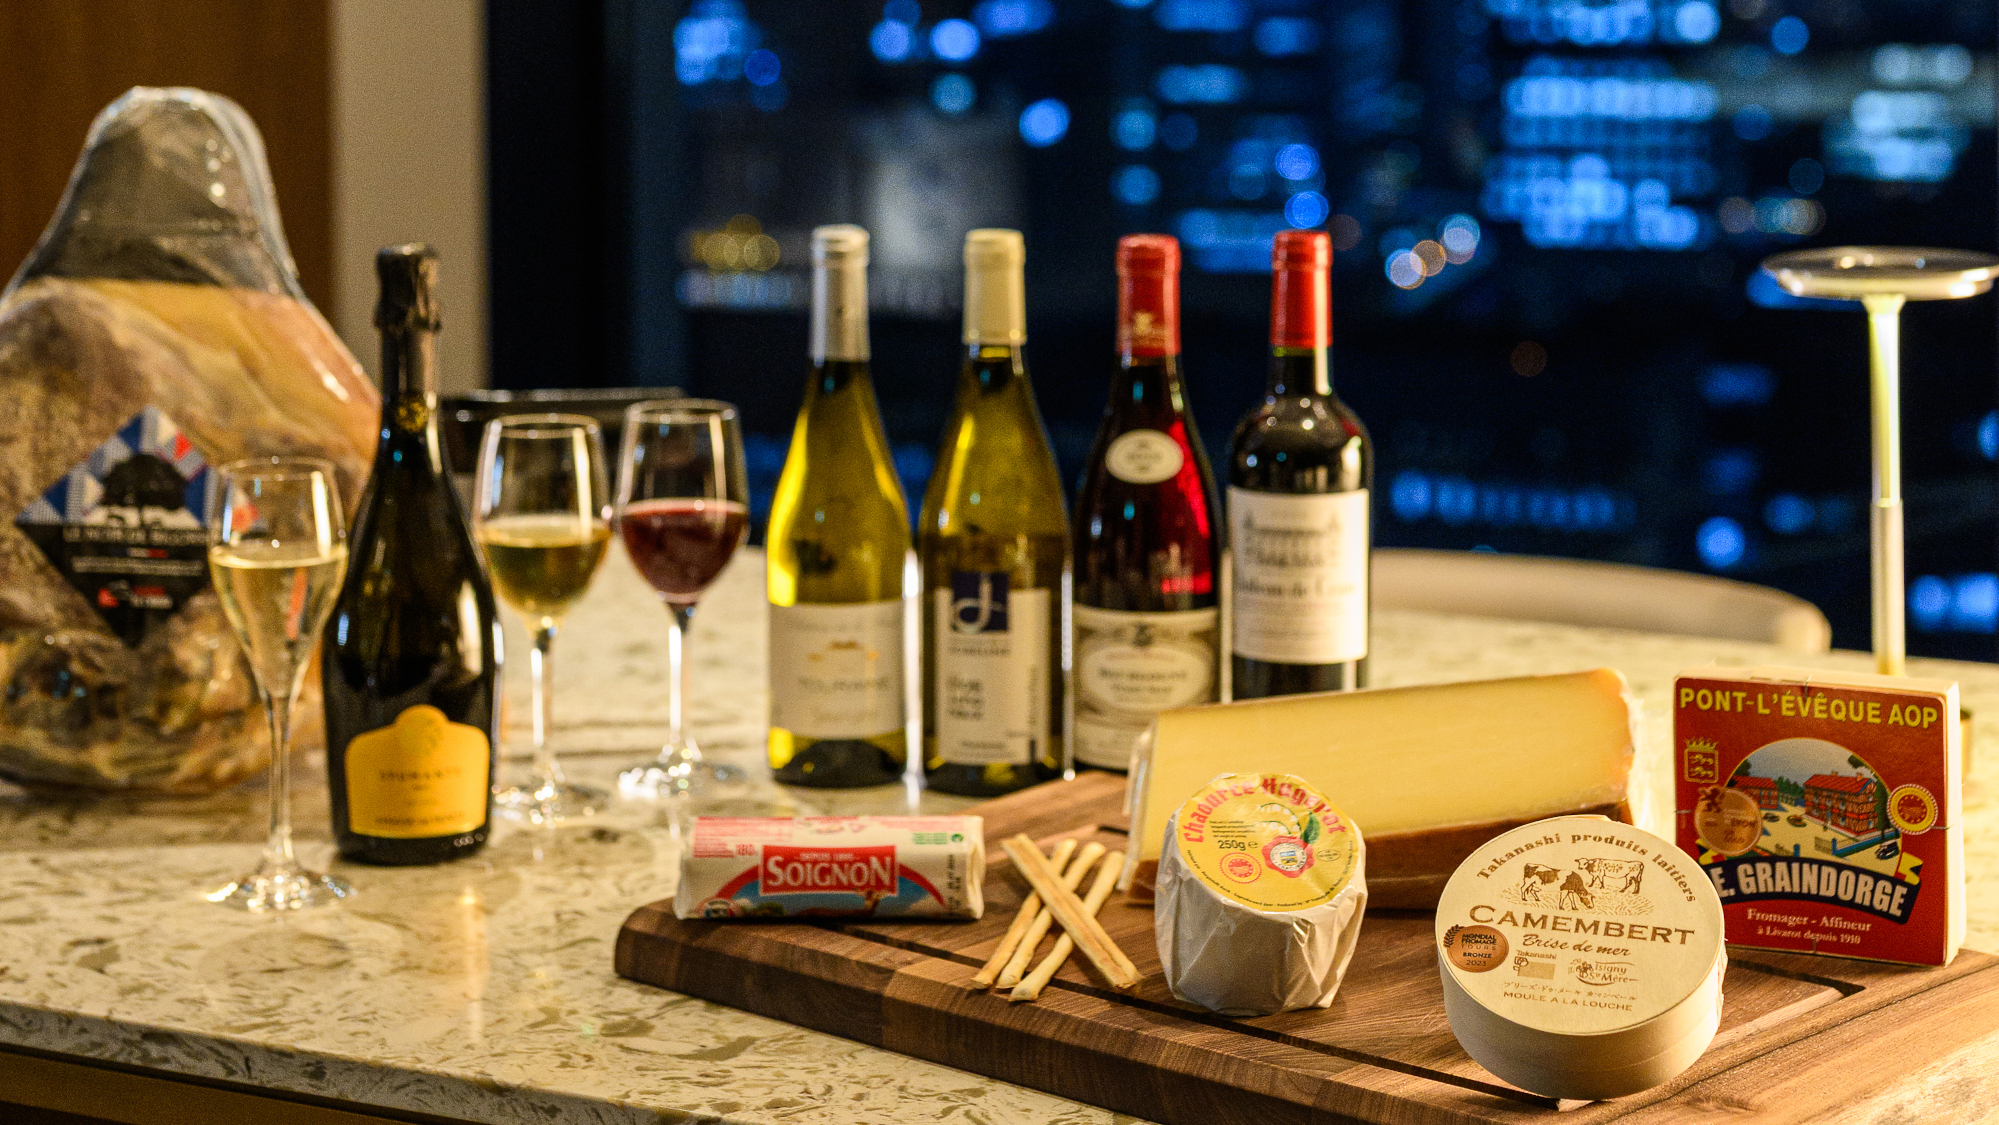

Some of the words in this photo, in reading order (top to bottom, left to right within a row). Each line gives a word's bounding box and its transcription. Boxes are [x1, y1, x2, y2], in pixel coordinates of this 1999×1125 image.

[1679, 687, 1883, 725] PONT-L'ÉVÊQUE
[1887, 703, 1939, 730] AOP
[1182, 782, 1255, 843] Chaource
[1217, 840, 1246, 852] 250g
[767, 855, 892, 887] SOIGNON
[1477, 833, 1562, 880] Takanashi
[1570, 832, 1649, 856] produits
[1652, 853, 1696, 903] laitiers
[1710, 866, 1736, 898] E.
[1737, 861, 1909, 918] GRAINDORGE
[1469, 904, 1696, 946] CAMEMBERT
[1747, 908, 1809, 927] Fromager
[1819, 916, 1872, 932] Affineur
[1461, 938, 1497, 946] FROMAGE
[1522, 933, 1570, 951] Brise
[1573, 940, 1593, 954] de
[1596, 946, 1632, 957] mer
[1803, 930, 1838, 943] depuis
[1516, 949, 1557, 960] Takanashi
[1595, 963, 1627, 975] Isigny
[1503, 991, 1547, 1002] MOULE
[1562, 998, 1579, 1006] LA
[1582, 999, 1633, 1012] LOUCHE
